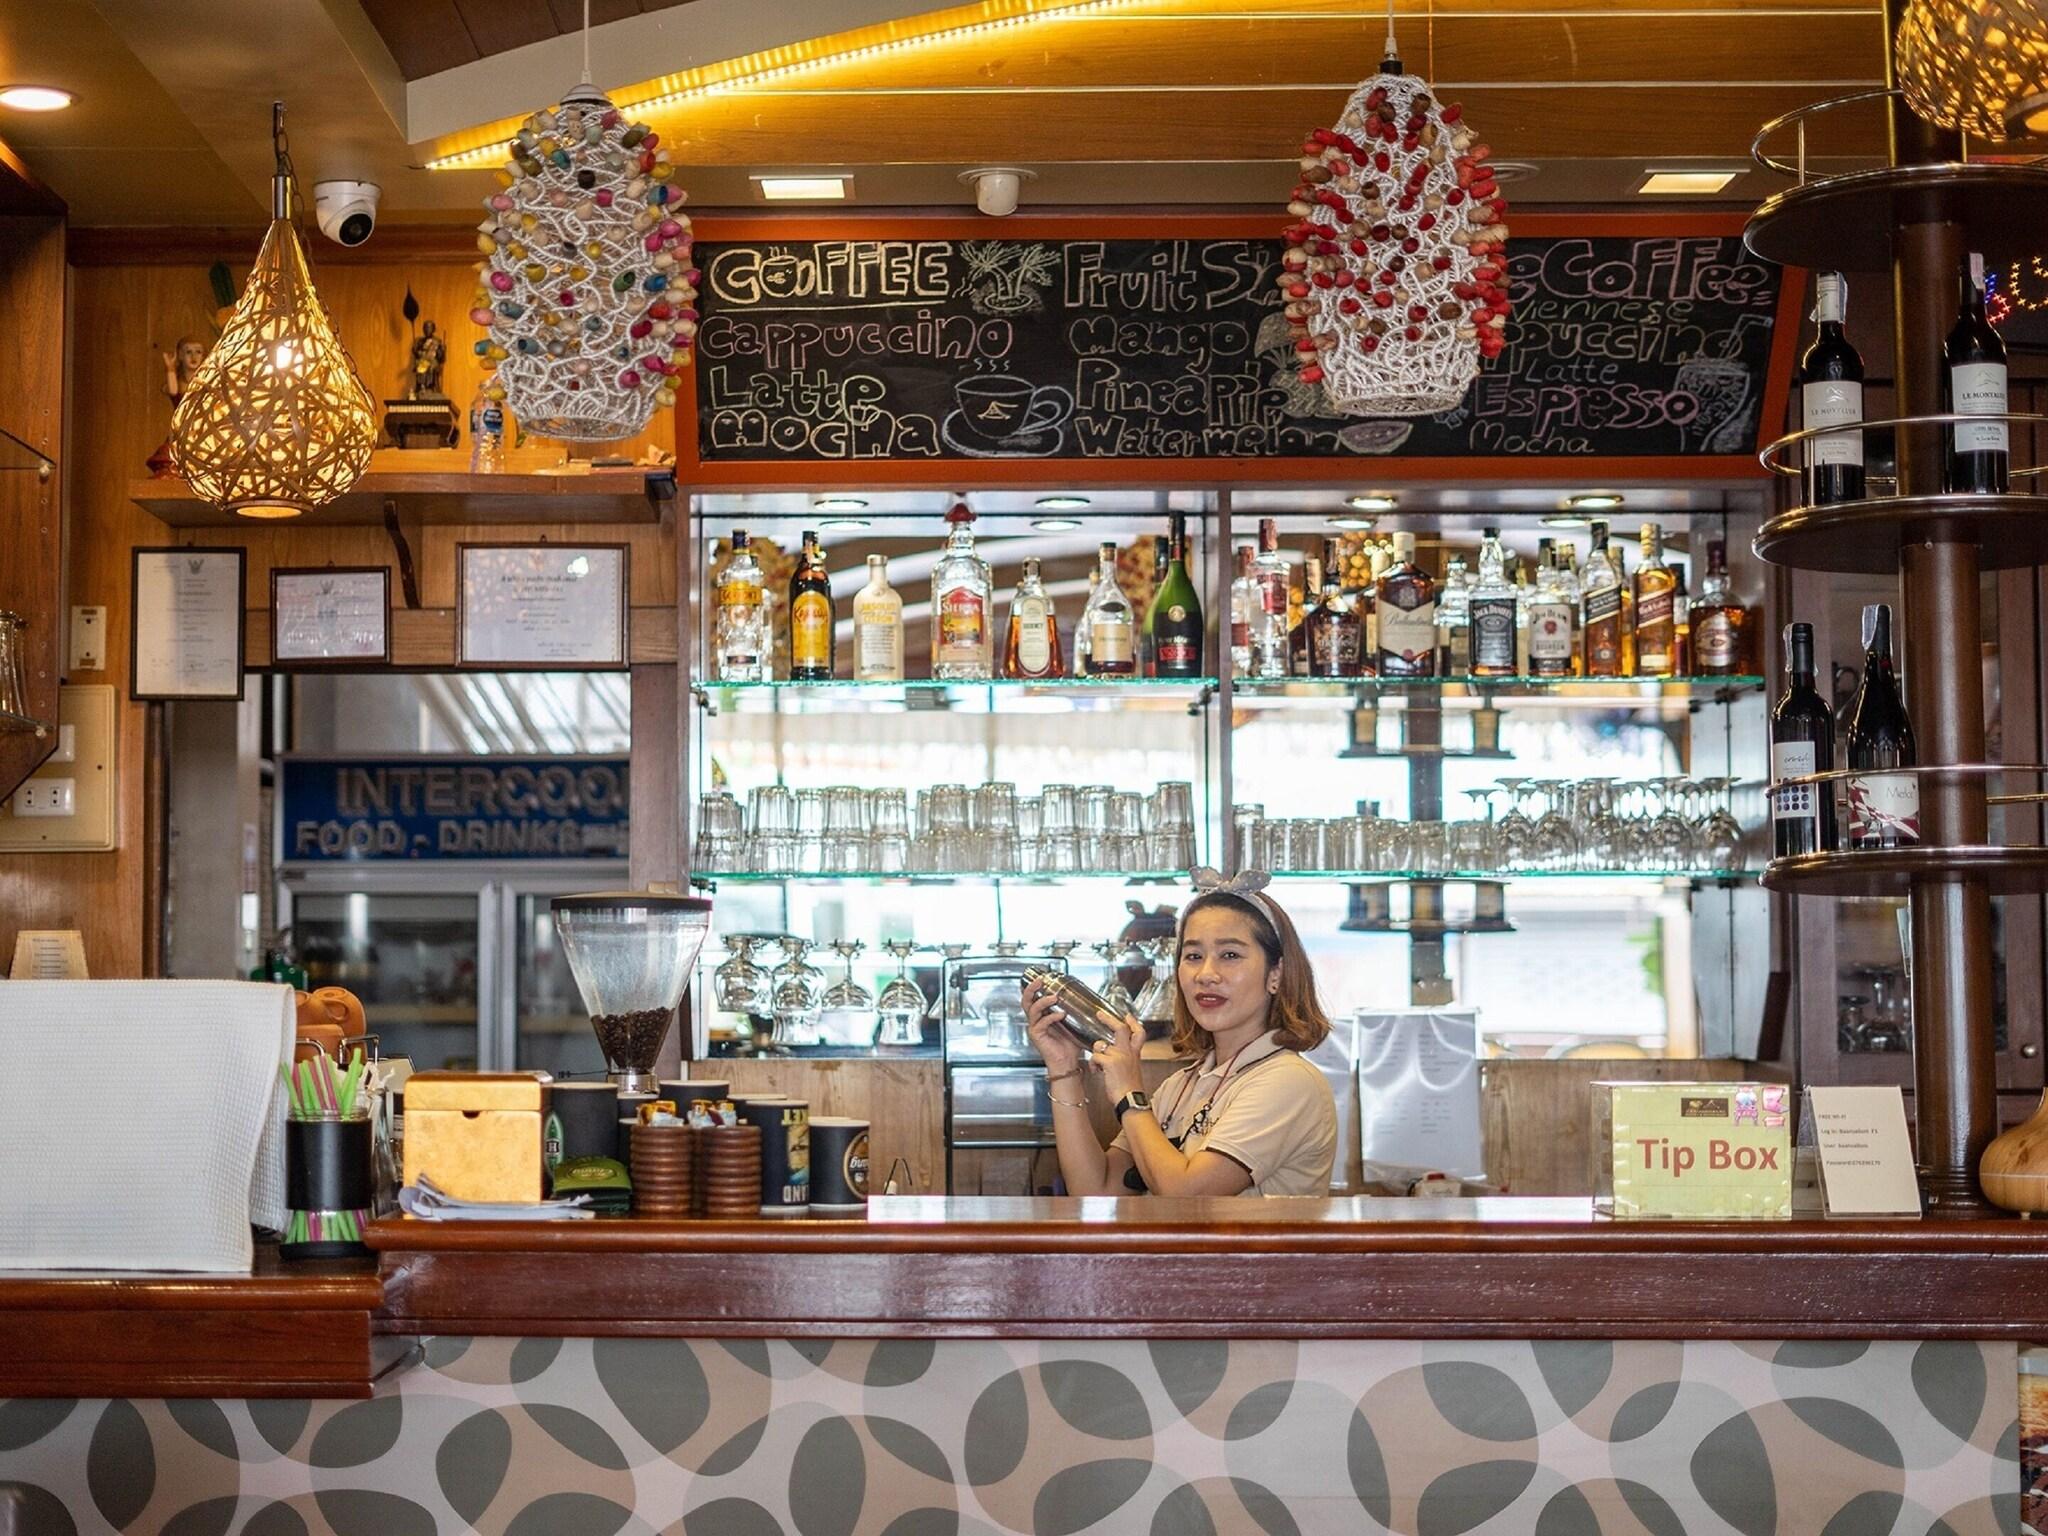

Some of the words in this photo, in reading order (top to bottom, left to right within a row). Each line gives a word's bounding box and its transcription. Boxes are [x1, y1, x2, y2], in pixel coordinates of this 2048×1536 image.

[1064, 240, 1198, 313] Fruit
[700, 309, 1013, 371] Cappuccino
[1069, 315, 1249, 375] Mango
[710, 365, 886, 424] Latte
[1524, 356, 1618, 385] Latte
[1475, 374, 1699, 438] Espresso
[1469, 420, 1595, 453] Mocha
[296, 820, 406, 855] FOOD
[1636, 1138, 1696, 1178] Tip
[1709, 1140, 1779, 1170] Box
